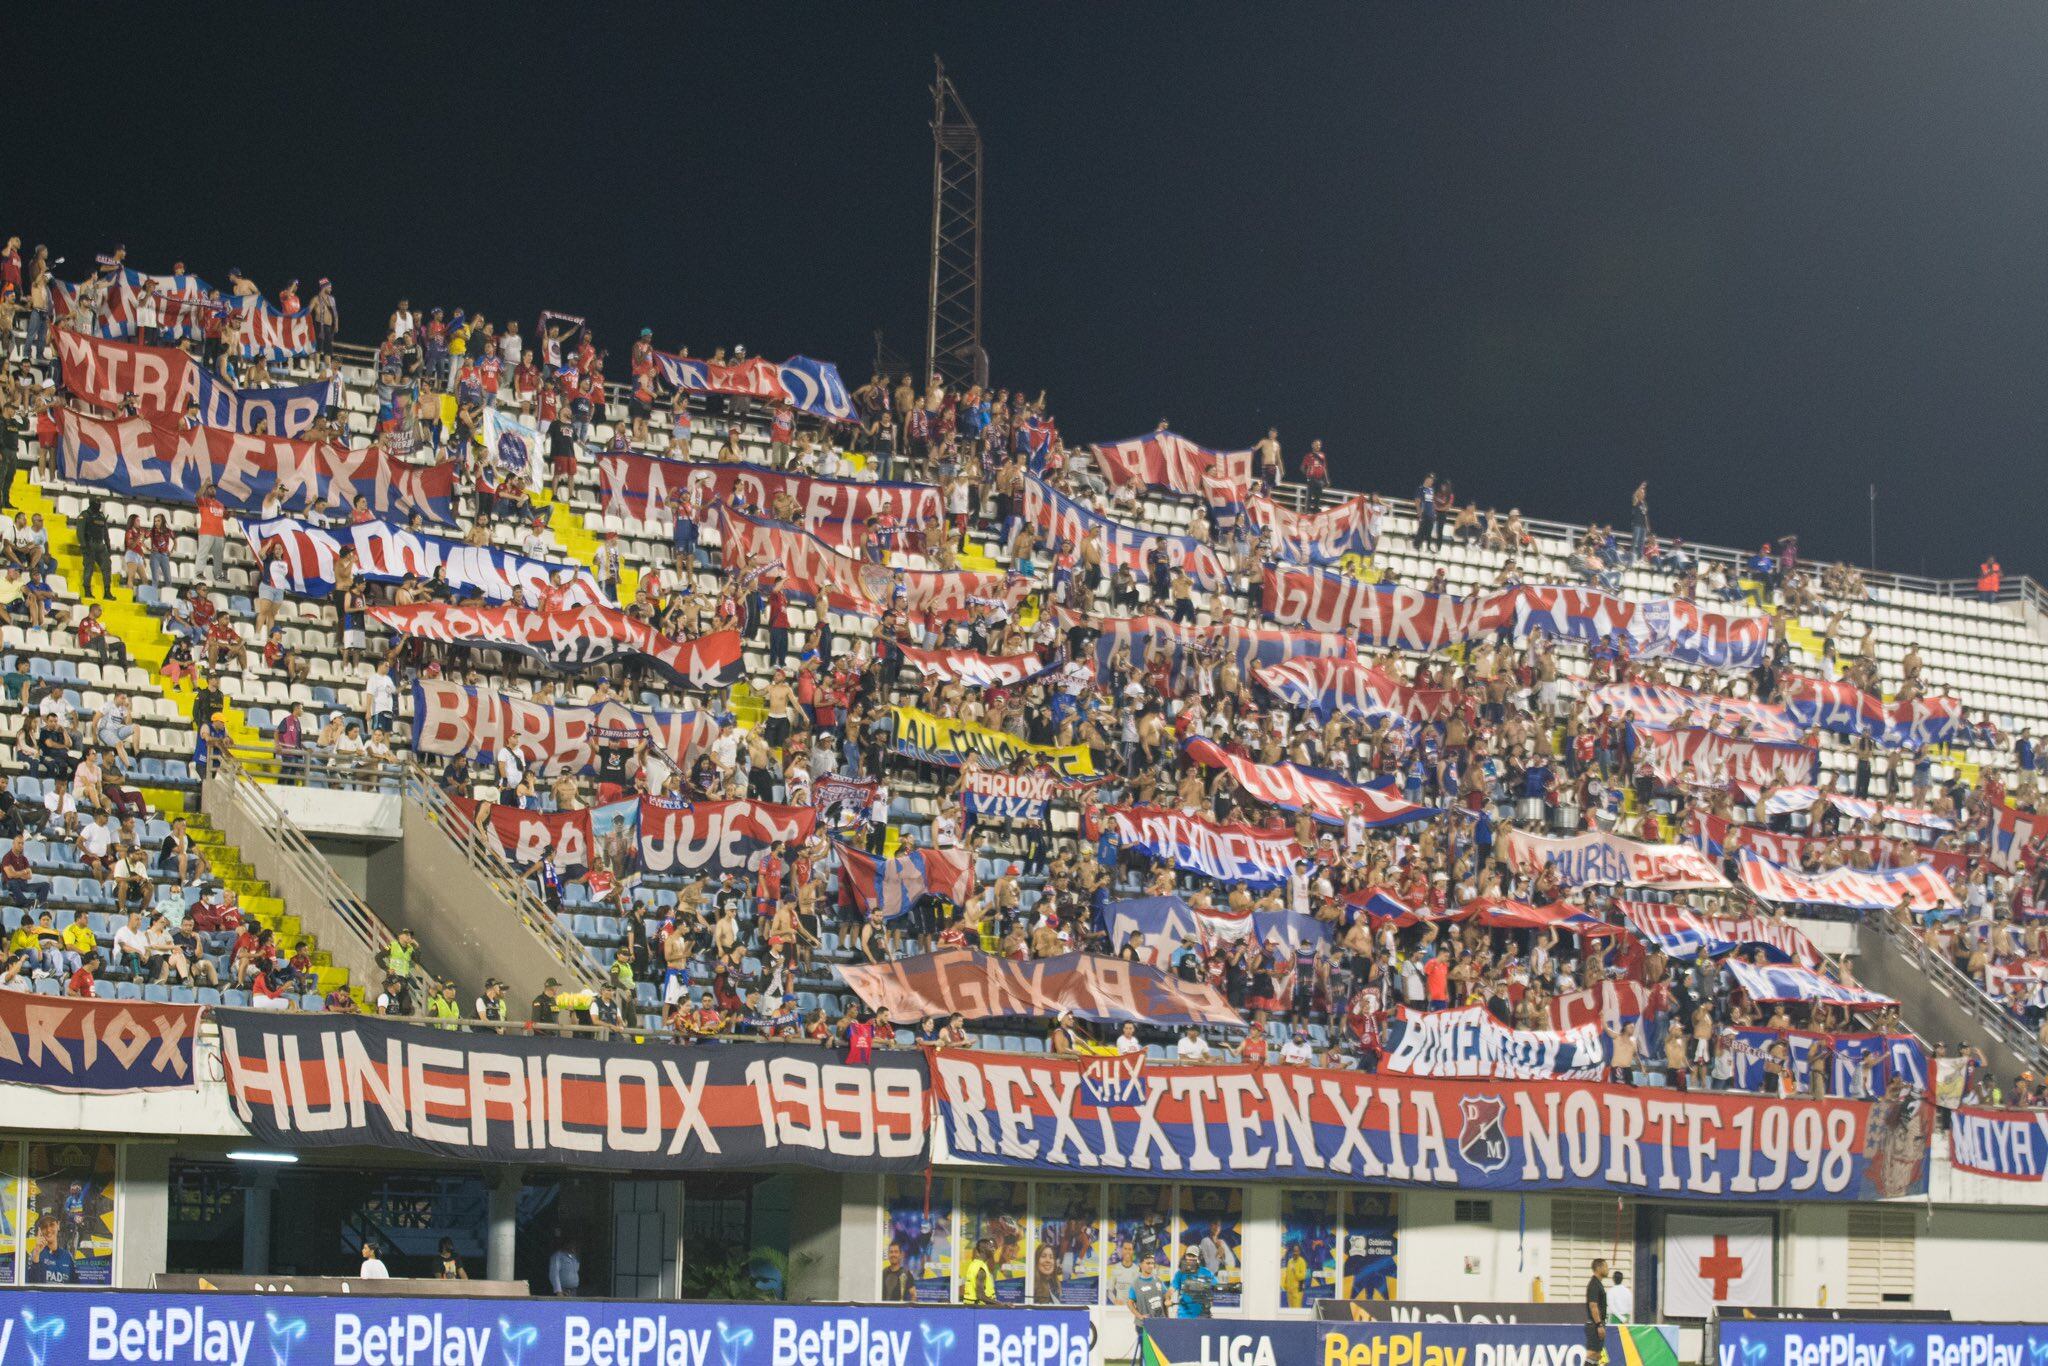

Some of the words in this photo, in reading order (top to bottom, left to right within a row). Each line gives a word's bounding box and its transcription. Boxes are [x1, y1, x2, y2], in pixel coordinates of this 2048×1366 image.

[58, 330, 319, 441] MIRADOR
[1275, 564, 1500, 651] GUARNE
[973, 793, 1042, 819] VIVE
[1547, 841, 1632, 883] MURGA
[220, 1027, 722, 1156] HUNERICOX
[745, 1057, 925, 1158] 1999
[1081, 1054, 1146, 1103] CHX
[935, 1057, 1458, 1184] REXIXTENXIA
[1514, 1091, 1722, 1195] NORTE
[1729, 1104, 1857, 1195] 1998
[1951, 1111, 2037, 1176] MOYA
[89, 1307, 255, 1366] BetPlay
[335, 1313, 490, 1366] BetPlay
[564, 1315, 711, 1366] BetPlay
[772, 1316, 911, 1366] BetPlay
[978, 1320, 1090, 1366] BetPla
[1200, 1335, 1276, 1366] LIGA
[1325, 1331, 1466, 1366] BetPlay
[1477, 1344, 1590, 1366] DIMAYO
[1784, 1333, 1885, 1366] BetPlay
[1926, 1333, 2023, 1366] BetPlay
